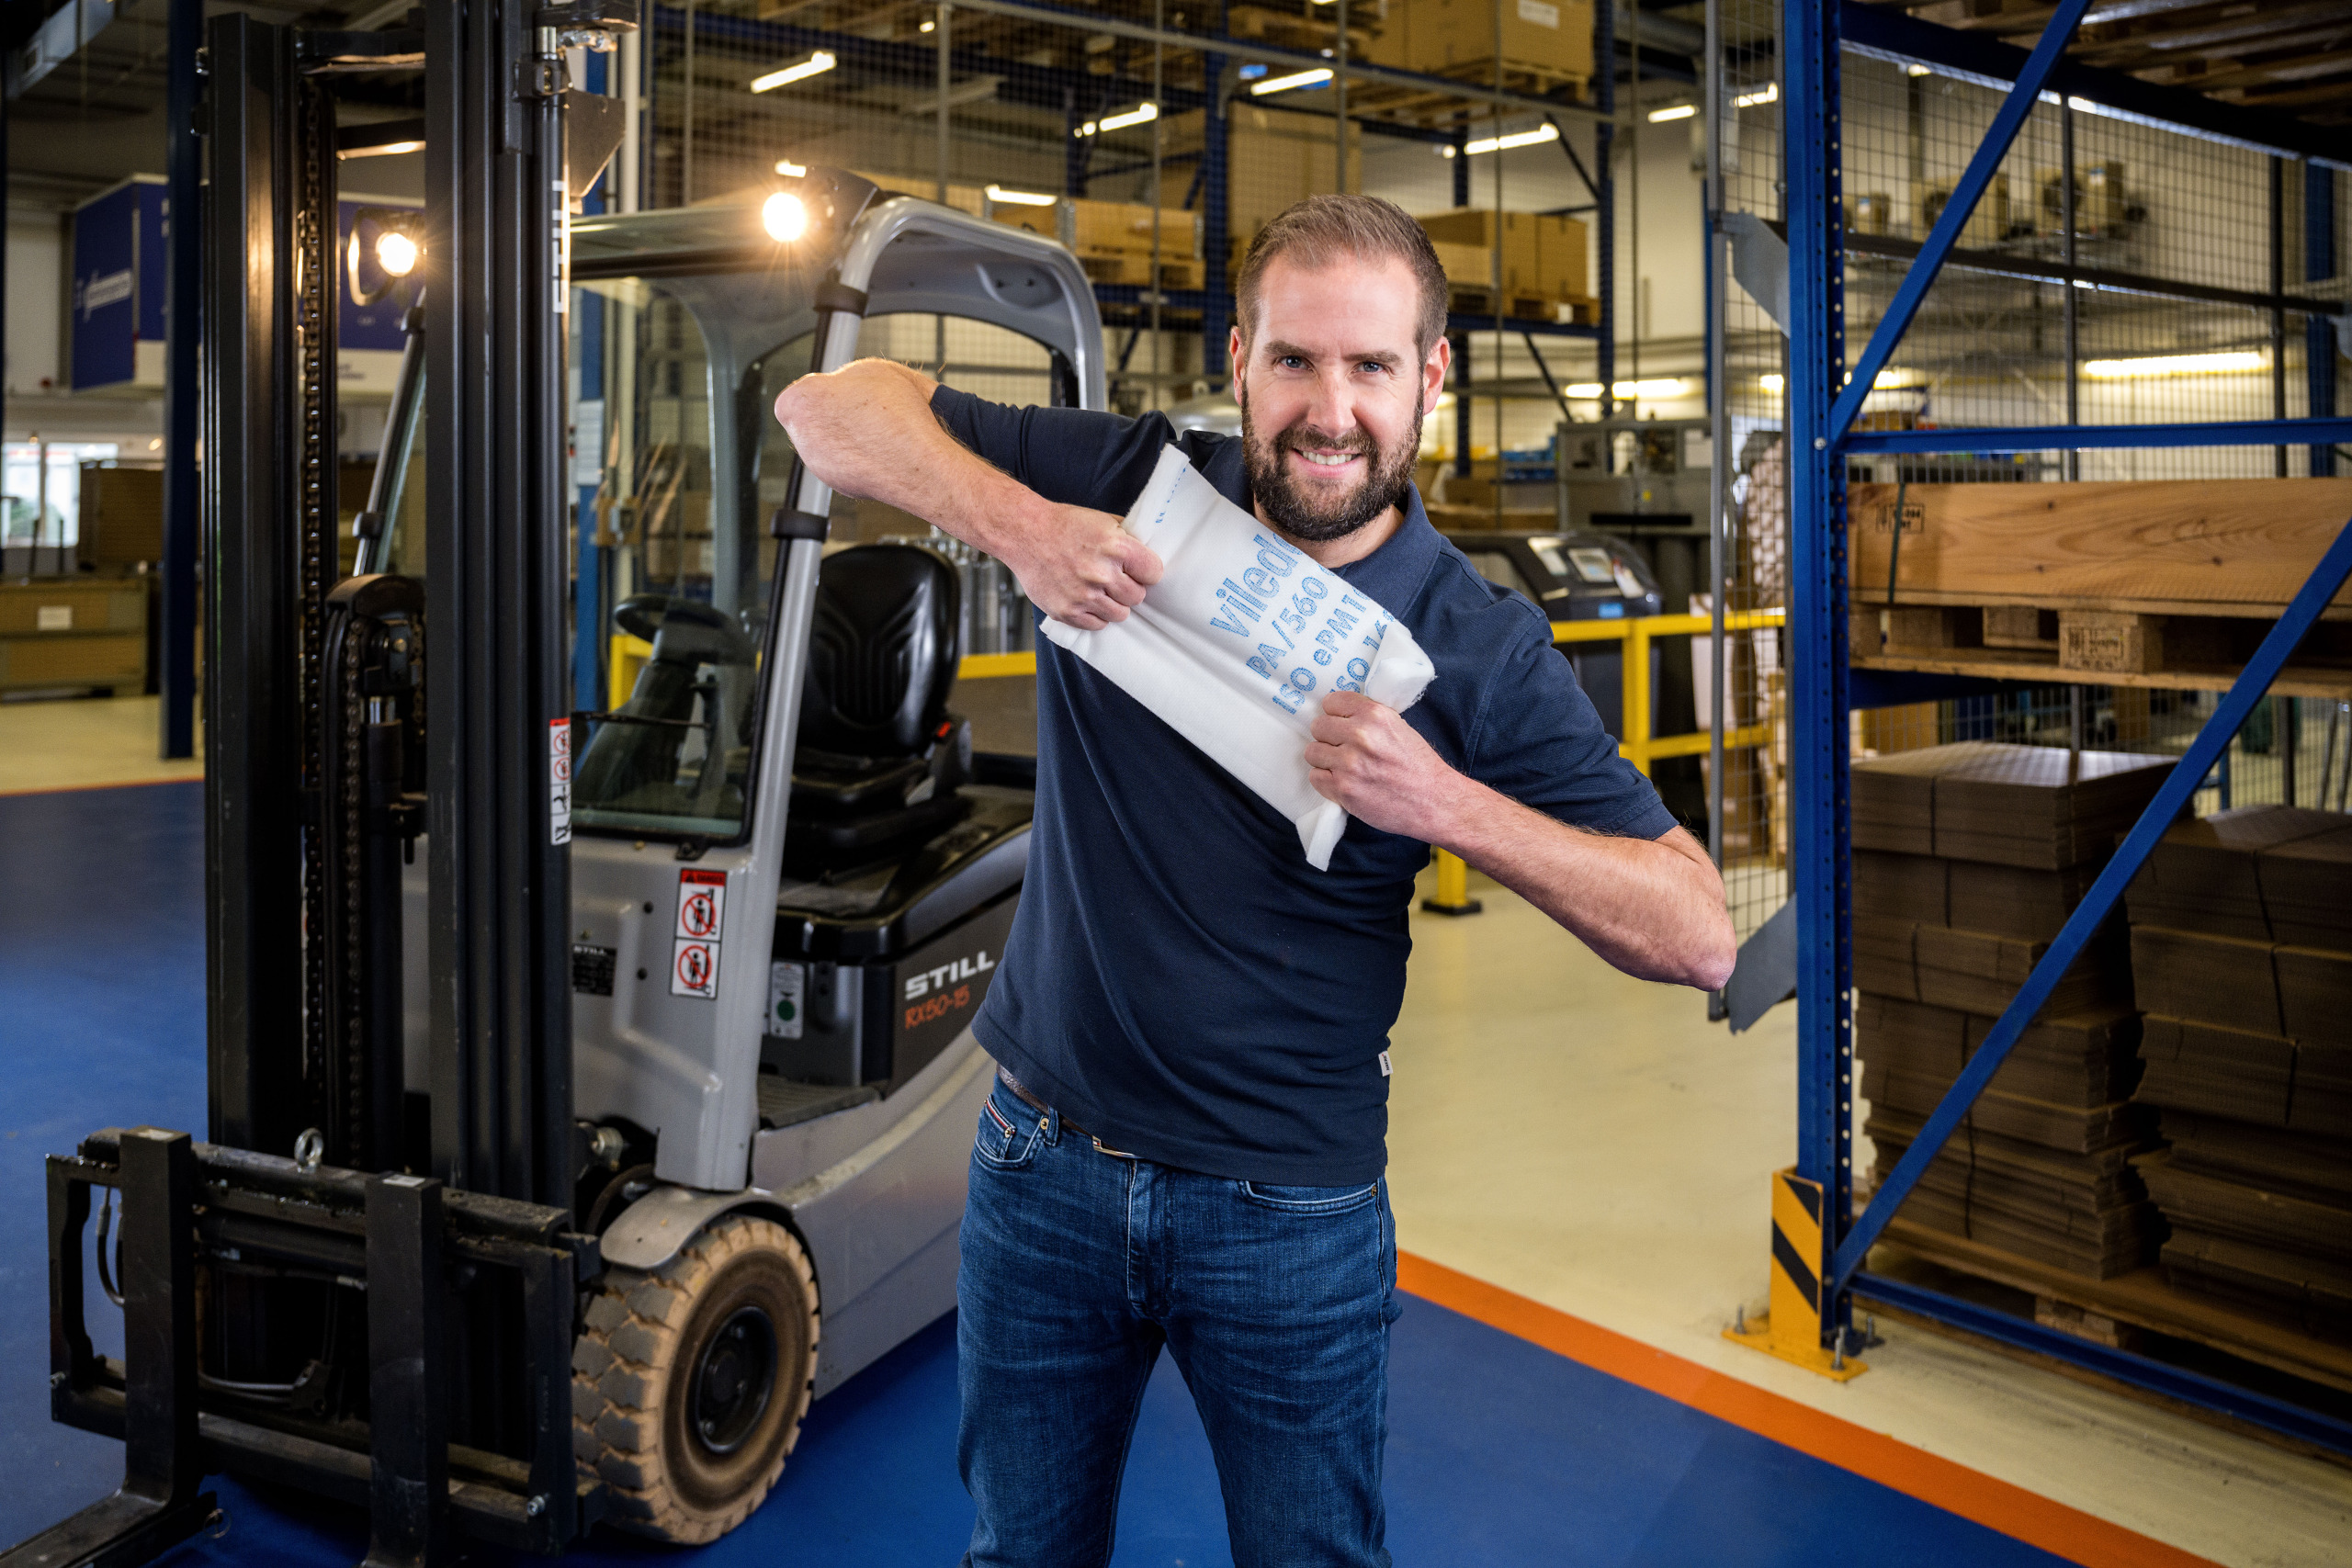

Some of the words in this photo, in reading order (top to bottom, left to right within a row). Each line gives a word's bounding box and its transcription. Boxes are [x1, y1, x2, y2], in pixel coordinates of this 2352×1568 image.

[1246, 576, 1328, 680] PA/560
[1272, 667, 1317, 715] ISO
[1329, 657, 1370, 694] SO
[905, 951, 995, 1001] STILL
